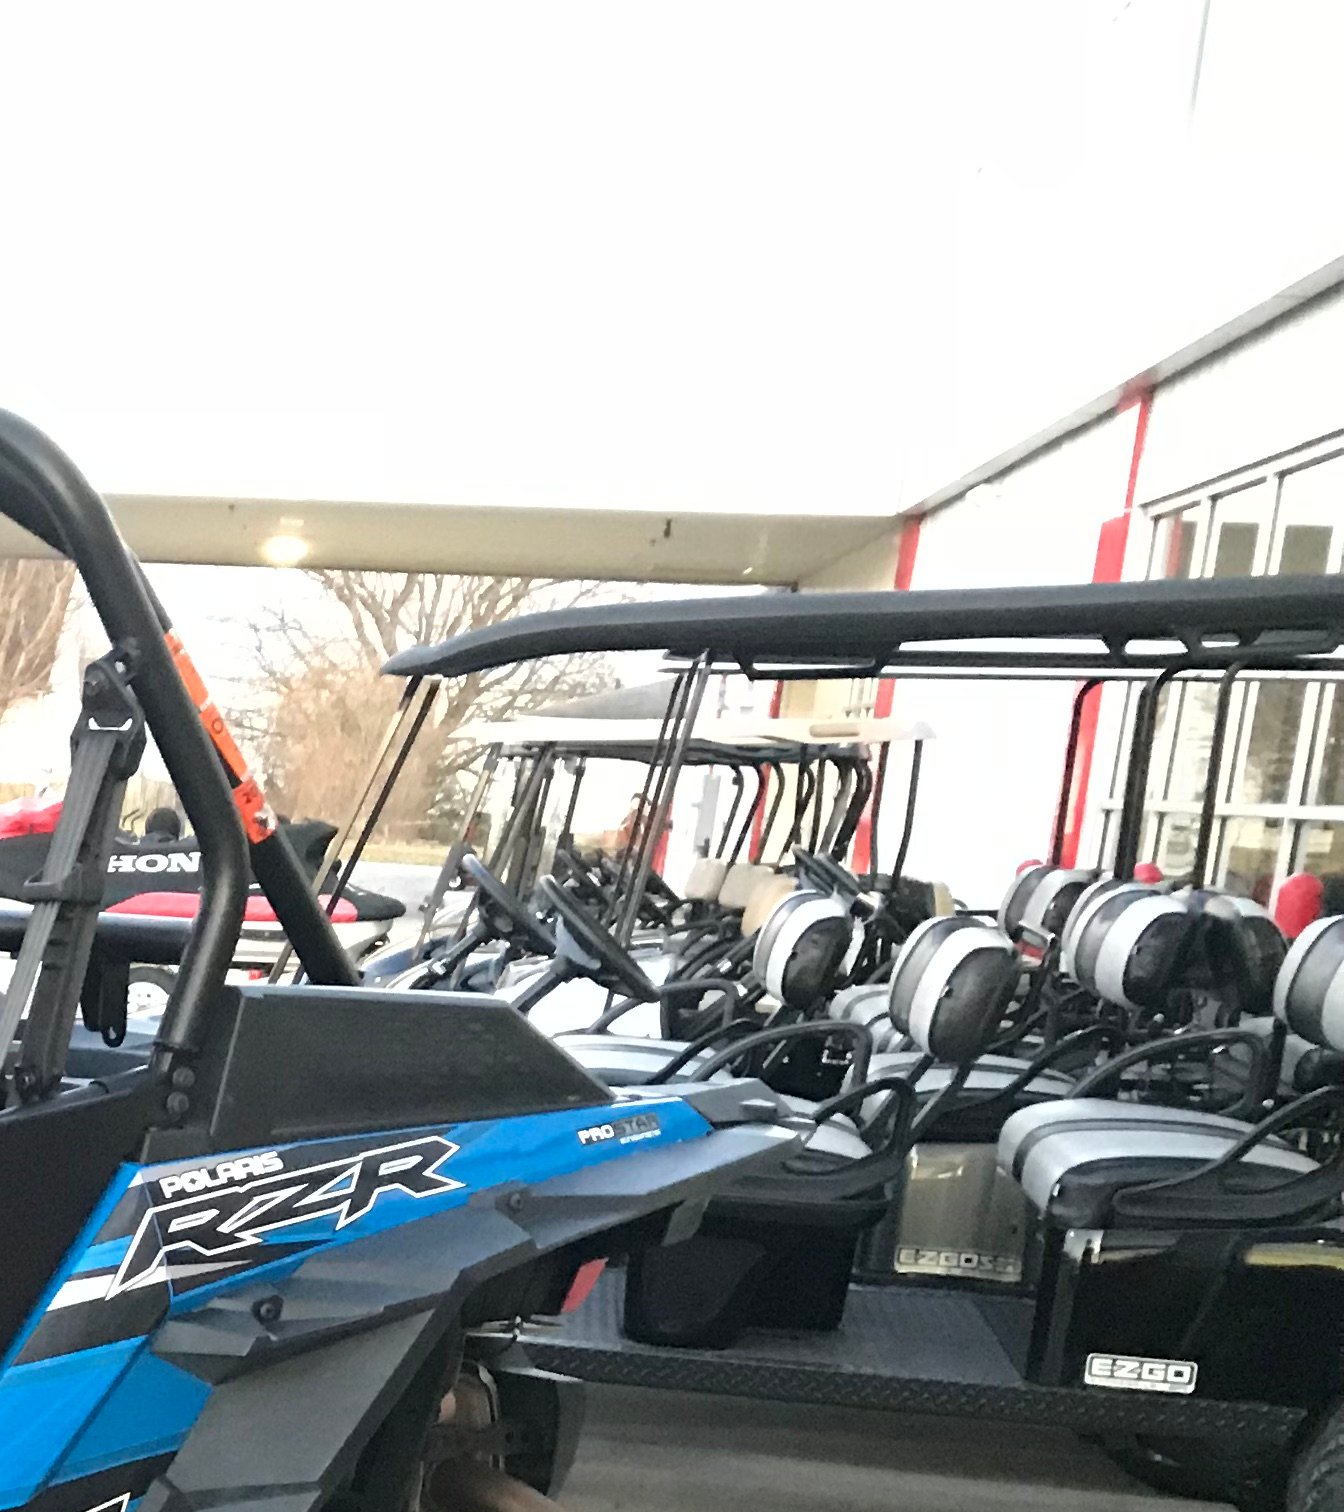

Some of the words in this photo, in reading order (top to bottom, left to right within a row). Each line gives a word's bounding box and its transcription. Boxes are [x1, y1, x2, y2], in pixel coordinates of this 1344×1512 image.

[107, 851, 202, 873] HON
[159, 1151, 284, 1199] POLARIS
[106, 1135, 467, 1300] RZR
[1091, 1358, 1192, 1383] EZGO
